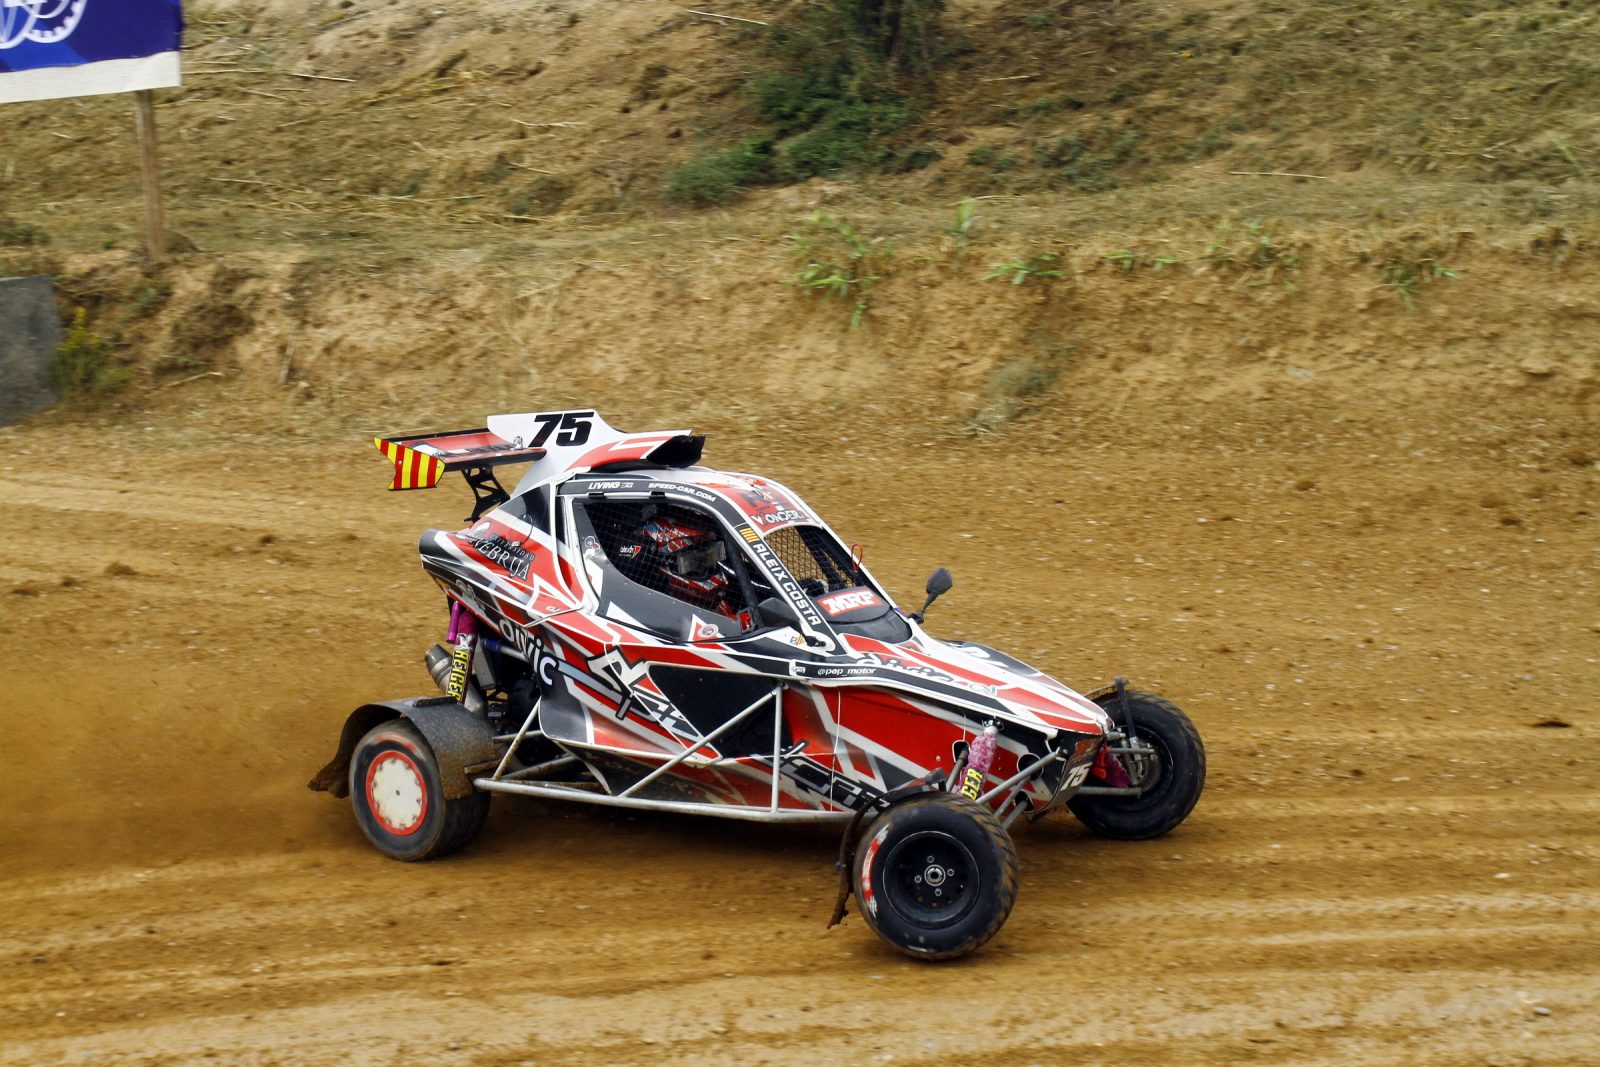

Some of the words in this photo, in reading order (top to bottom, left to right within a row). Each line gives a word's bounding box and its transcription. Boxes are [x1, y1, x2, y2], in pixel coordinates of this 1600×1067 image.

[528, 411, 594, 447] 75
[588, 481, 620, 490] LIVING
[648, 482, 716, 502] SPEED-CAR.COM
[753, 543, 788, 581] ALEIX
[783, 582, 821, 625] COSTA
[822, 590, 875, 614] MRF
[818, 668, 876, 677] @pep_motor
[1060, 762, 1094, 792] 75
